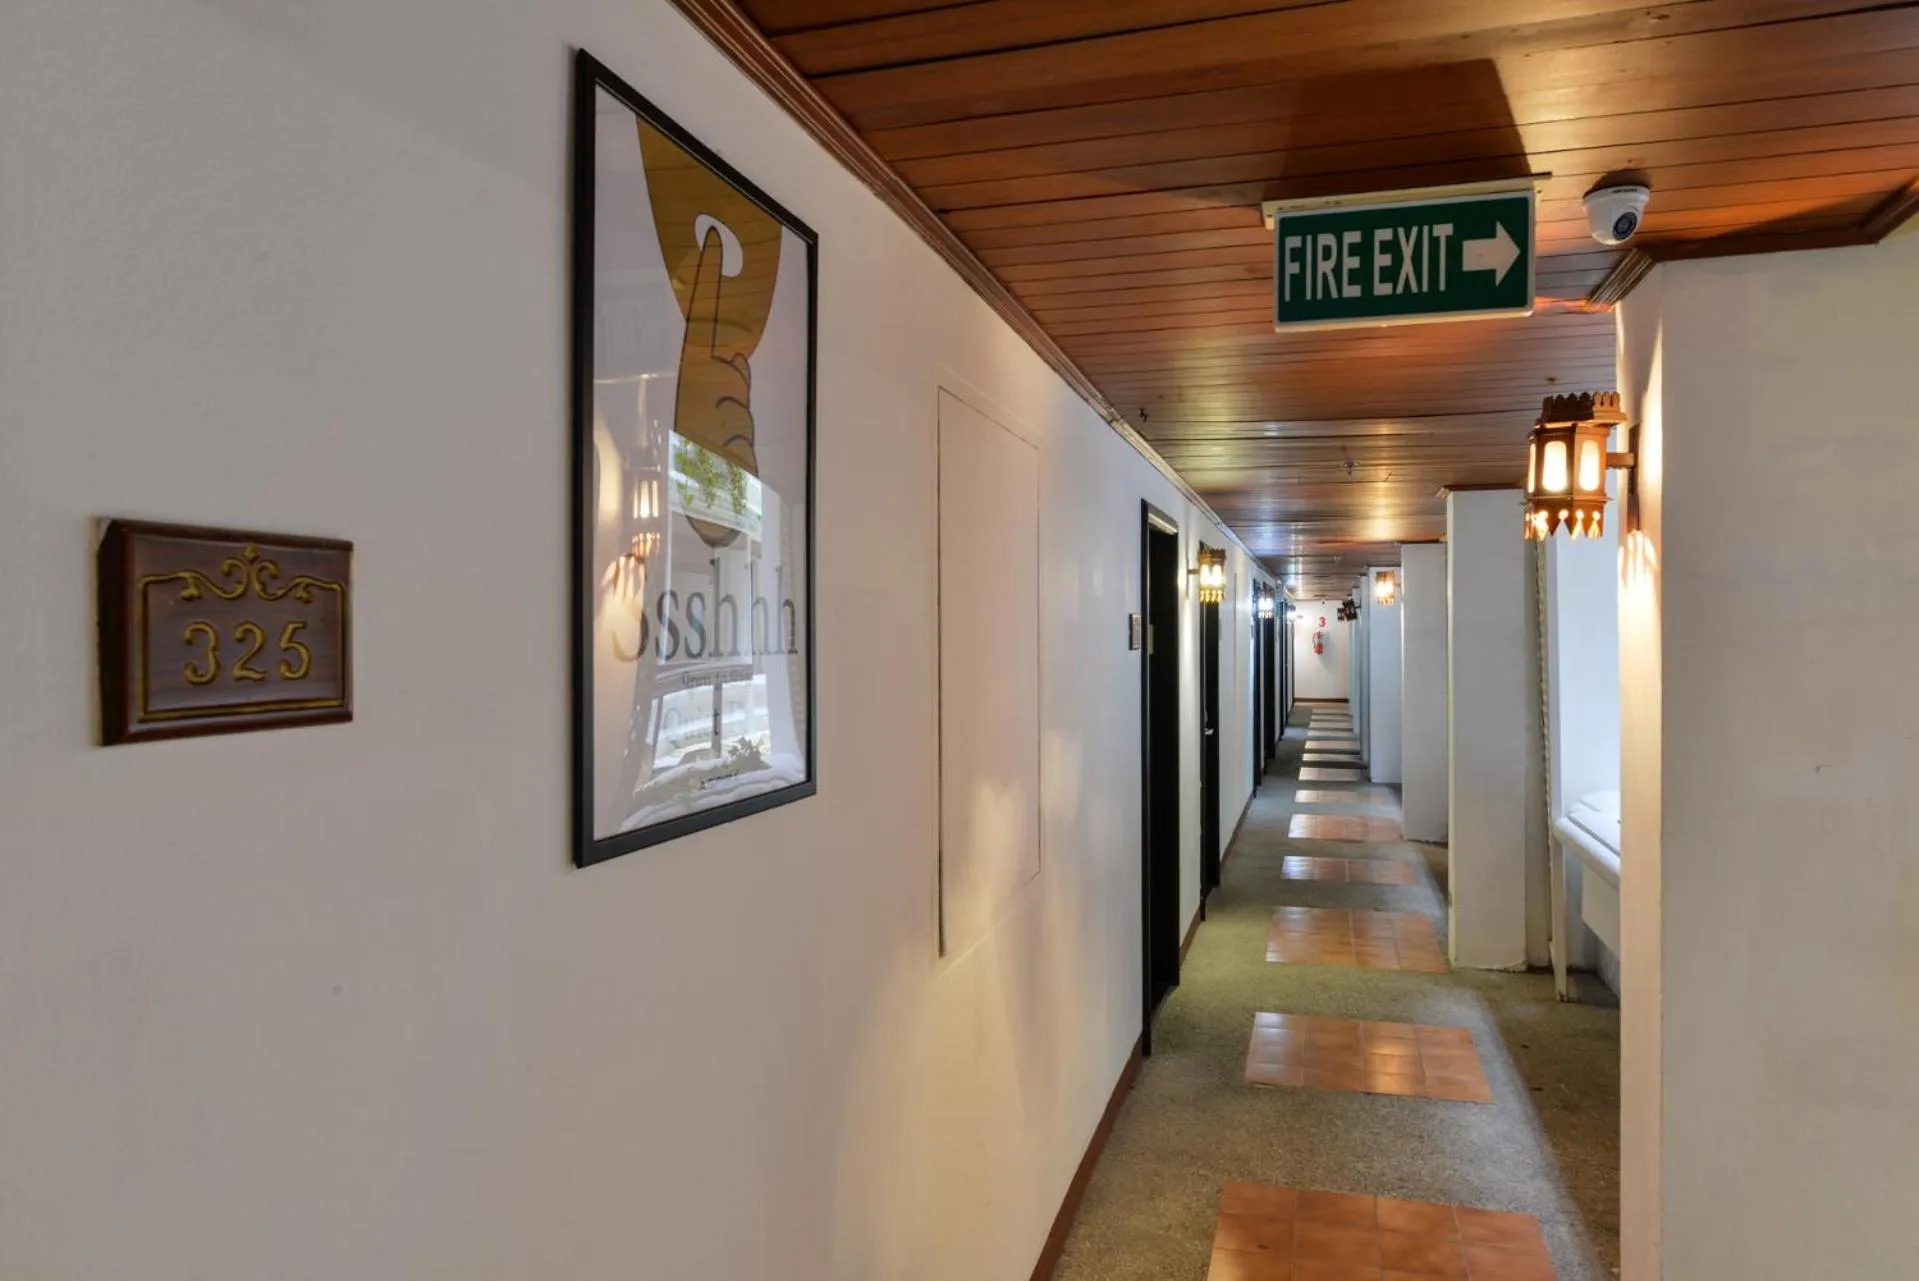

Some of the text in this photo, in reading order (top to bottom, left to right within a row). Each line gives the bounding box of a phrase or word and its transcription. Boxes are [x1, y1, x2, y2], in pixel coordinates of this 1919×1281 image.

[1284, 223, 1454, 302] FIRE EXIT
[183, 621, 312, 685] 325
[1318, 616, 1327, 628] 3
